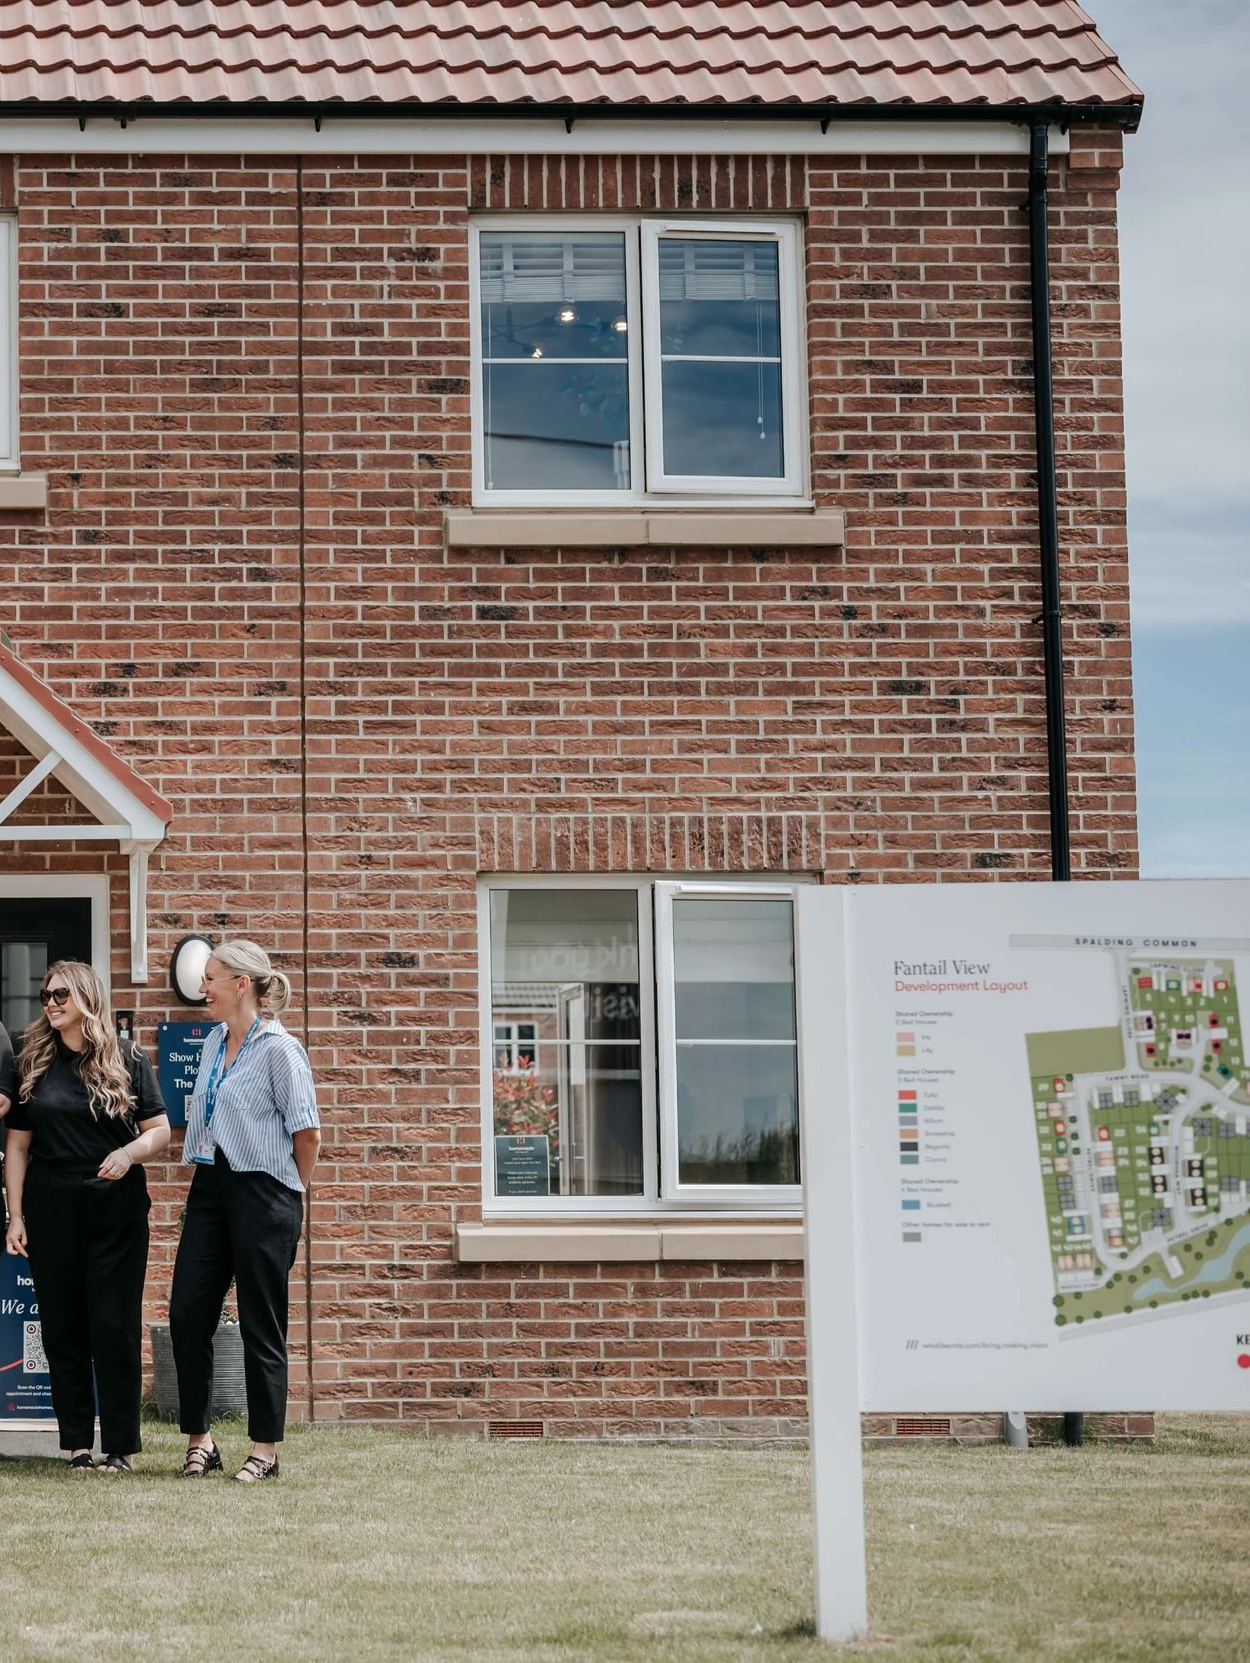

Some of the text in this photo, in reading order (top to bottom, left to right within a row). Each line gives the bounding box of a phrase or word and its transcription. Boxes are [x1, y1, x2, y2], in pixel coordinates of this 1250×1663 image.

[1075, 938, 1133, 946] SPALDING
[894, 960, 990, 975] Fantail View
[894, 980, 1028, 993] Development Layout
[169, 1052, 193, 1062] Show
[185, 1065, 200, 1074] Plo
[174, 1079, 193, 1088] The
[2, 1300, 39, 1314] We a
[1237, 1334, 1250, 1344] KE
